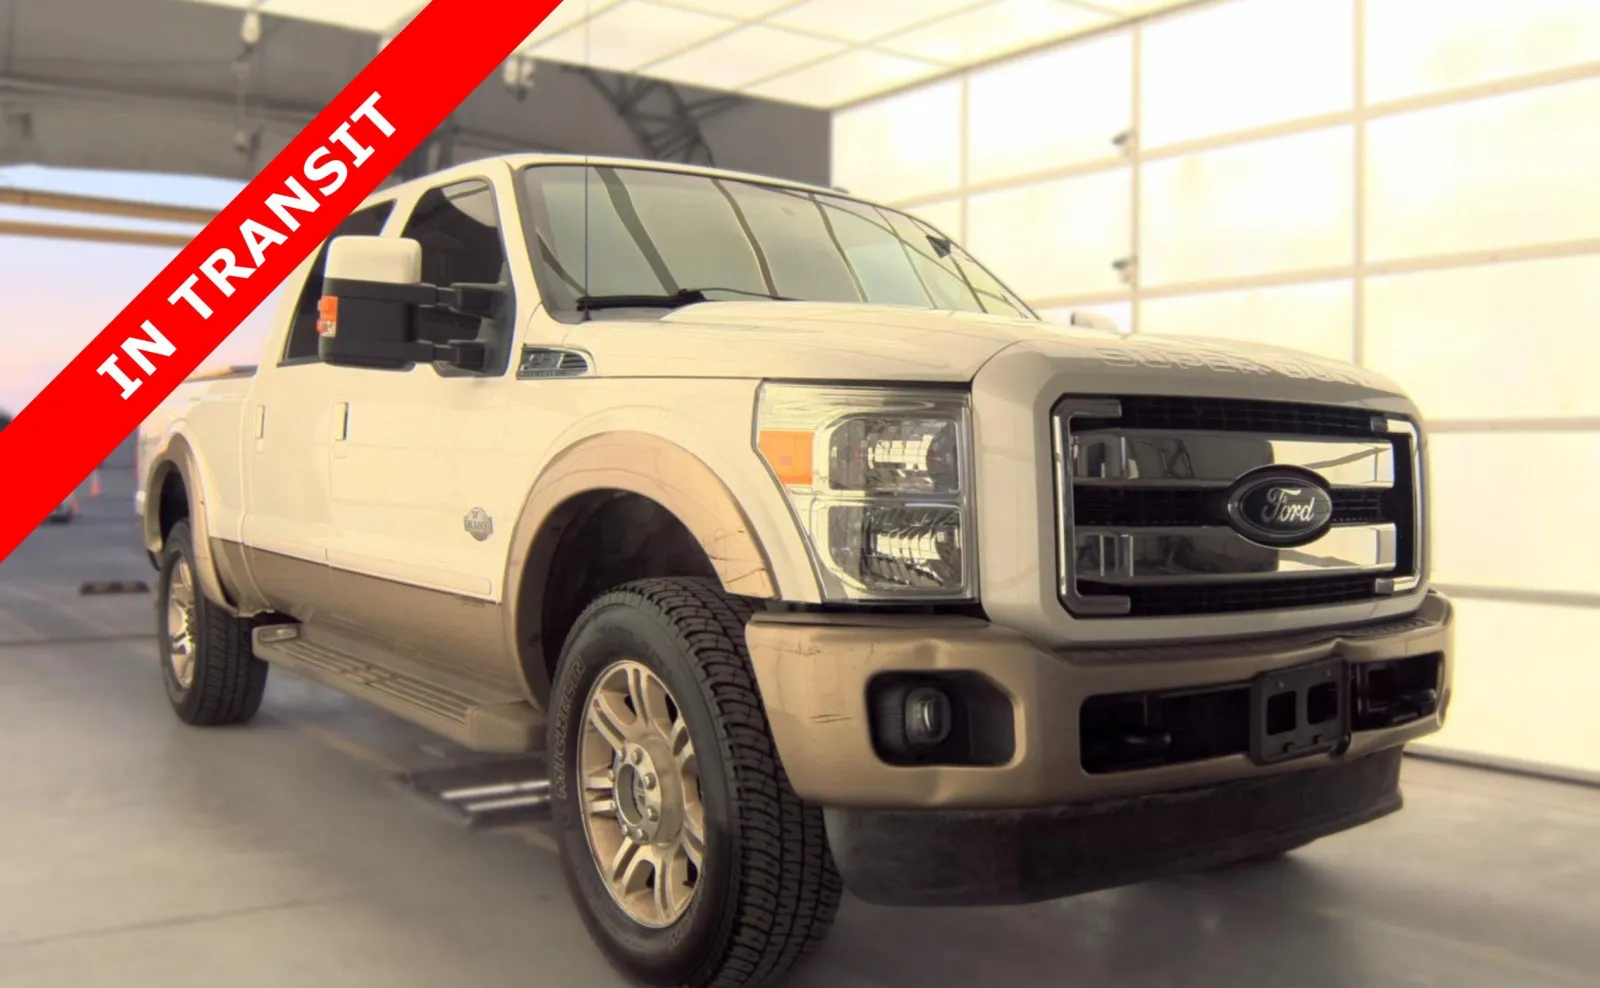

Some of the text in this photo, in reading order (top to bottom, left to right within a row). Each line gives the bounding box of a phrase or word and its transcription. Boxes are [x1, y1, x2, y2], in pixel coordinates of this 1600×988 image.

[1095, 348, 1274, 375] SUPER
[1261, 487, 1316, 522] Ford
[553, 654, 587, 800] MICHELIN
